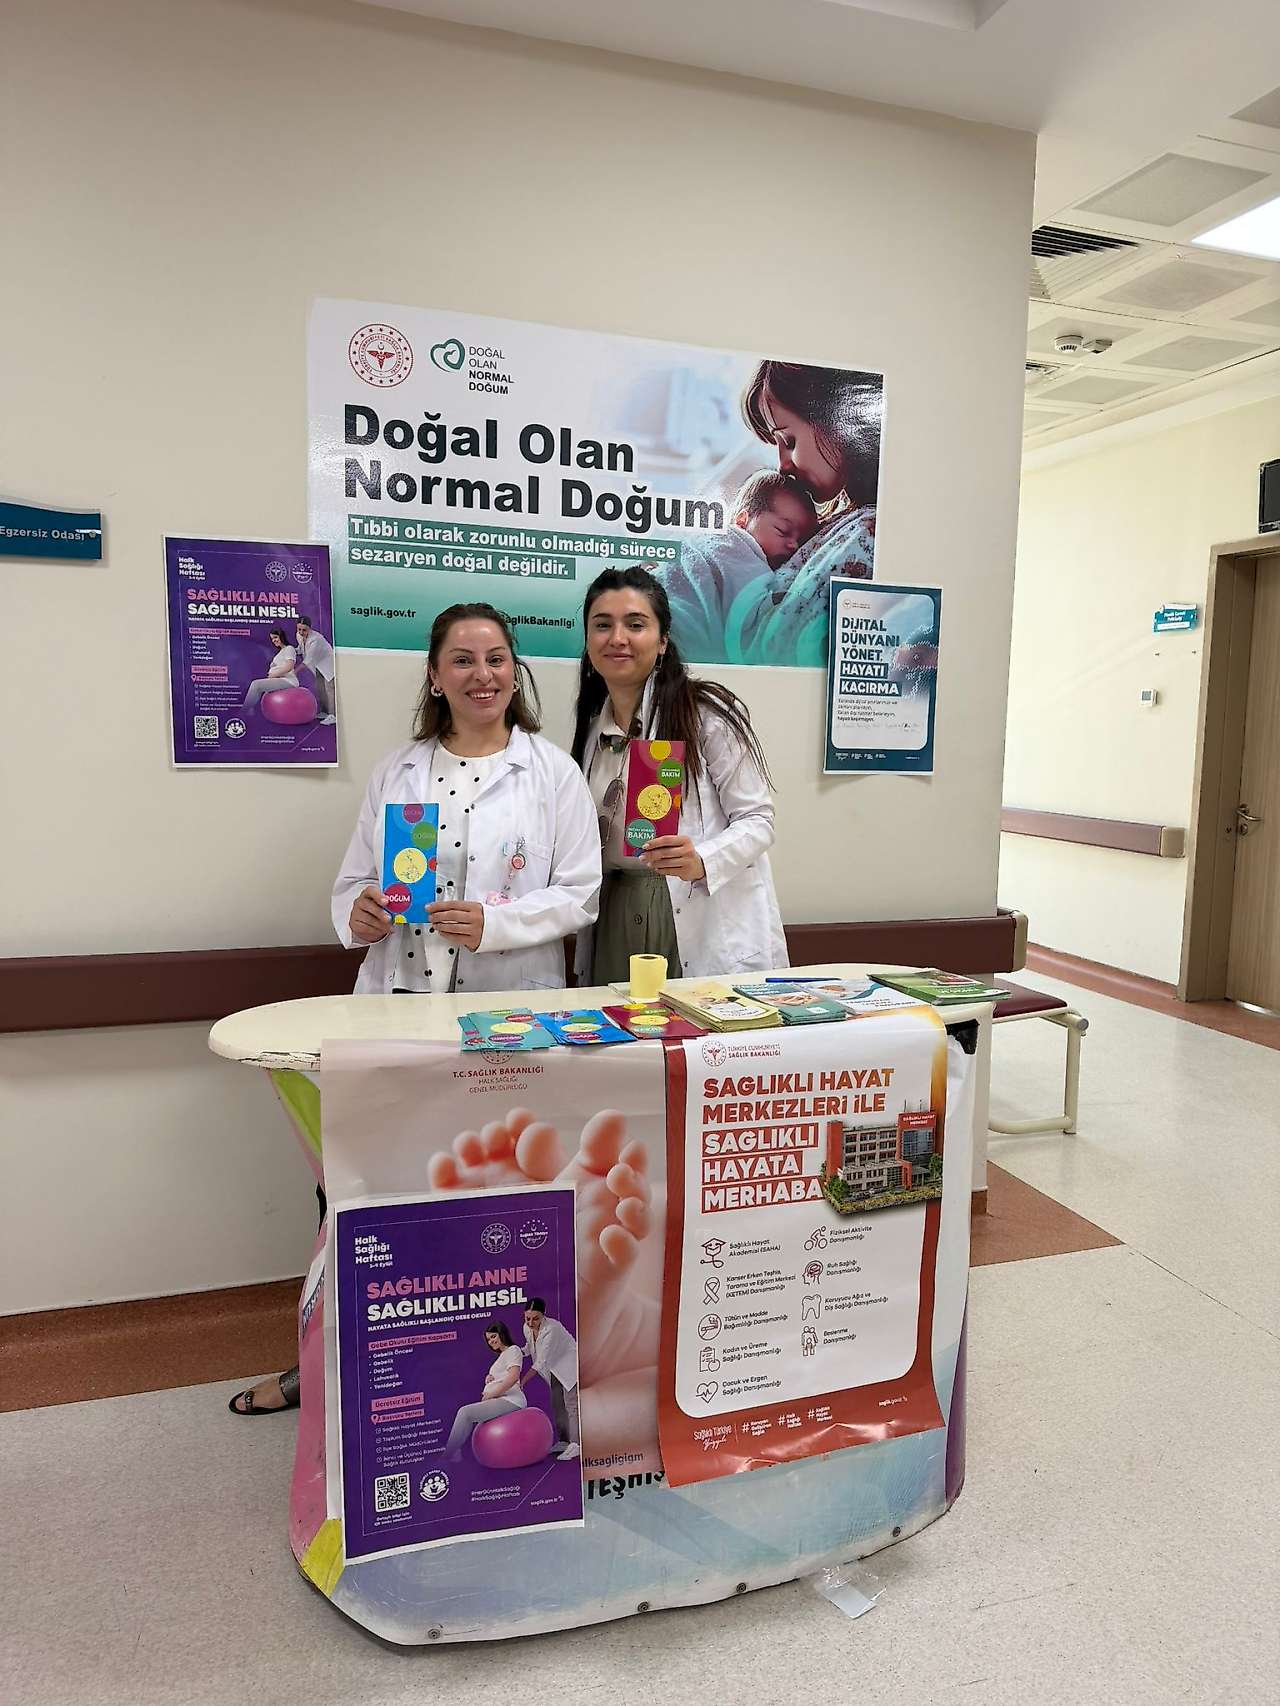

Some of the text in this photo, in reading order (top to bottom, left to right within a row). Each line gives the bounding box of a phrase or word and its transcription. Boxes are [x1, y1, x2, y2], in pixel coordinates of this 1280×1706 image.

[469, 358, 497, 370] OLAN
[469, 370, 515, 383] NORMAL
[469, 381, 509, 395] DOĞUM
[345, 404, 634, 473] Doğal Olan
[345, 456, 723, 535] Normal Doğum
[0, 525, 48, 538] Egzersiz
[350, 517, 677, 559] Tıbbi olarak zorunlu olmadığı sürece
[350, 547, 569, 577] sezaryen doğal değildir.
[187, 588, 299, 604] SAĞLIKLI ANNE
[188, 602, 299, 618] SAĞLIKLI NESİL
[350, 605, 416, 619] saglik.gov.tr
[842, 630, 900, 647] DÜNYANI
[843, 663, 884, 677] HAYATI
[628, 831, 655, 840] BAKIM
[467, 1069, 497, 1077] SAĞLIK
[819, 1068, 895, 1092] HAYAT
[469, 1086, 488, 1094] GENEL
[705, 1154, 801, 1183] HAYATA
[704, 1178, 824, 1212] MERHABA
[355, 1235, 377, 1245] Halk
[751, 1239, 770, 1248] Hayat
[355, 1244, 390, 1254] Sağlığı
[760, 1245, 781, 1254] (SAHA)
[356, 1253, 392, 1265] Haftası
[367, 1266, 529, 1299] SAĞLIKLI ANNE
[726, 1274, 746, 1283] Kanser
[747, 1272, 764, 1280] Erken
[726, 1282, 748, 1290] Tarama
[757, 1277, 775, 1287] Eğitim
[367, 1287, 528, 1322] SAĞLIKLI NESİL
[471, 1311, 492, 1319] OKULU
[722, 1346, 740, 1354] Kadın
[750, 1375, 768, 1384] Ergen
